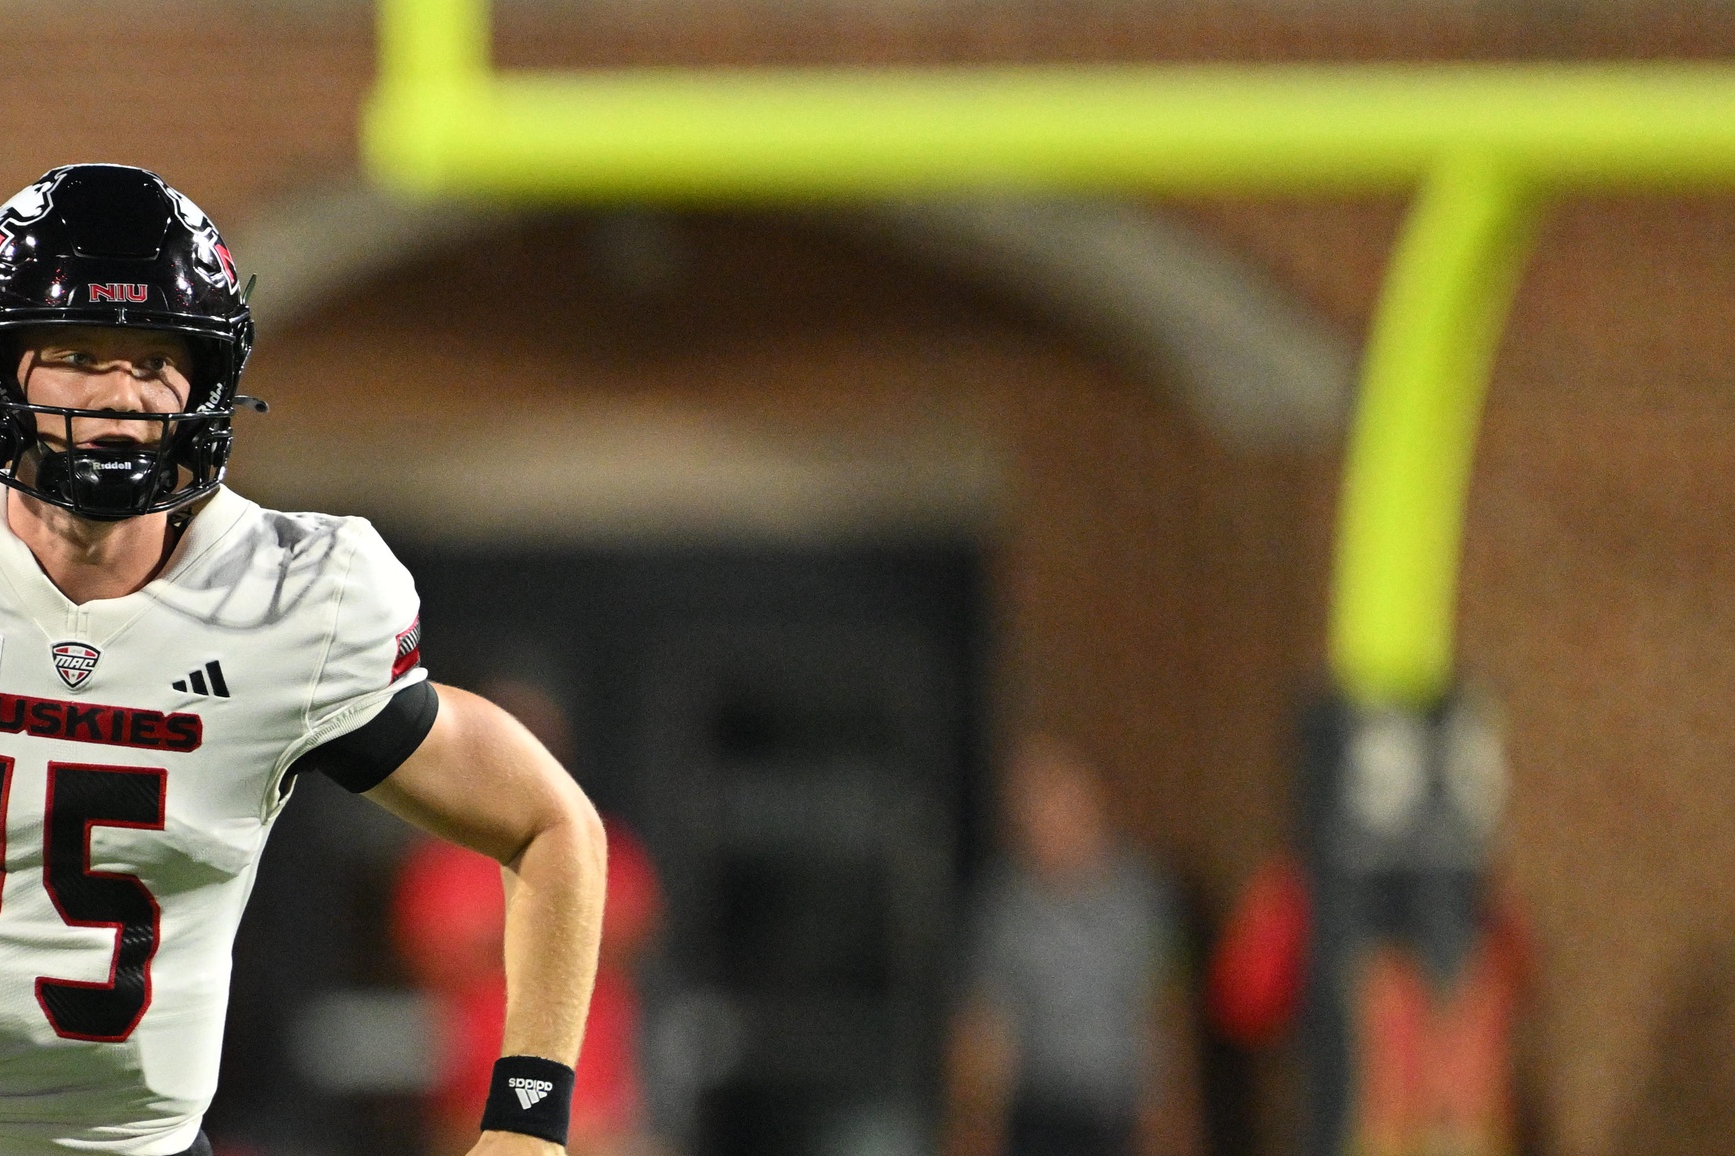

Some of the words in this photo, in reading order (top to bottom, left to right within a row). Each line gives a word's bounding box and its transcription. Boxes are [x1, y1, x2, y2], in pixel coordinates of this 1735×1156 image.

[88, 283, 148, 302] NIU
[92, 461, 132, 470] Riddell
[54, 654, 97, 670] MAC
[508, 1077, 553, 1092] adidas
